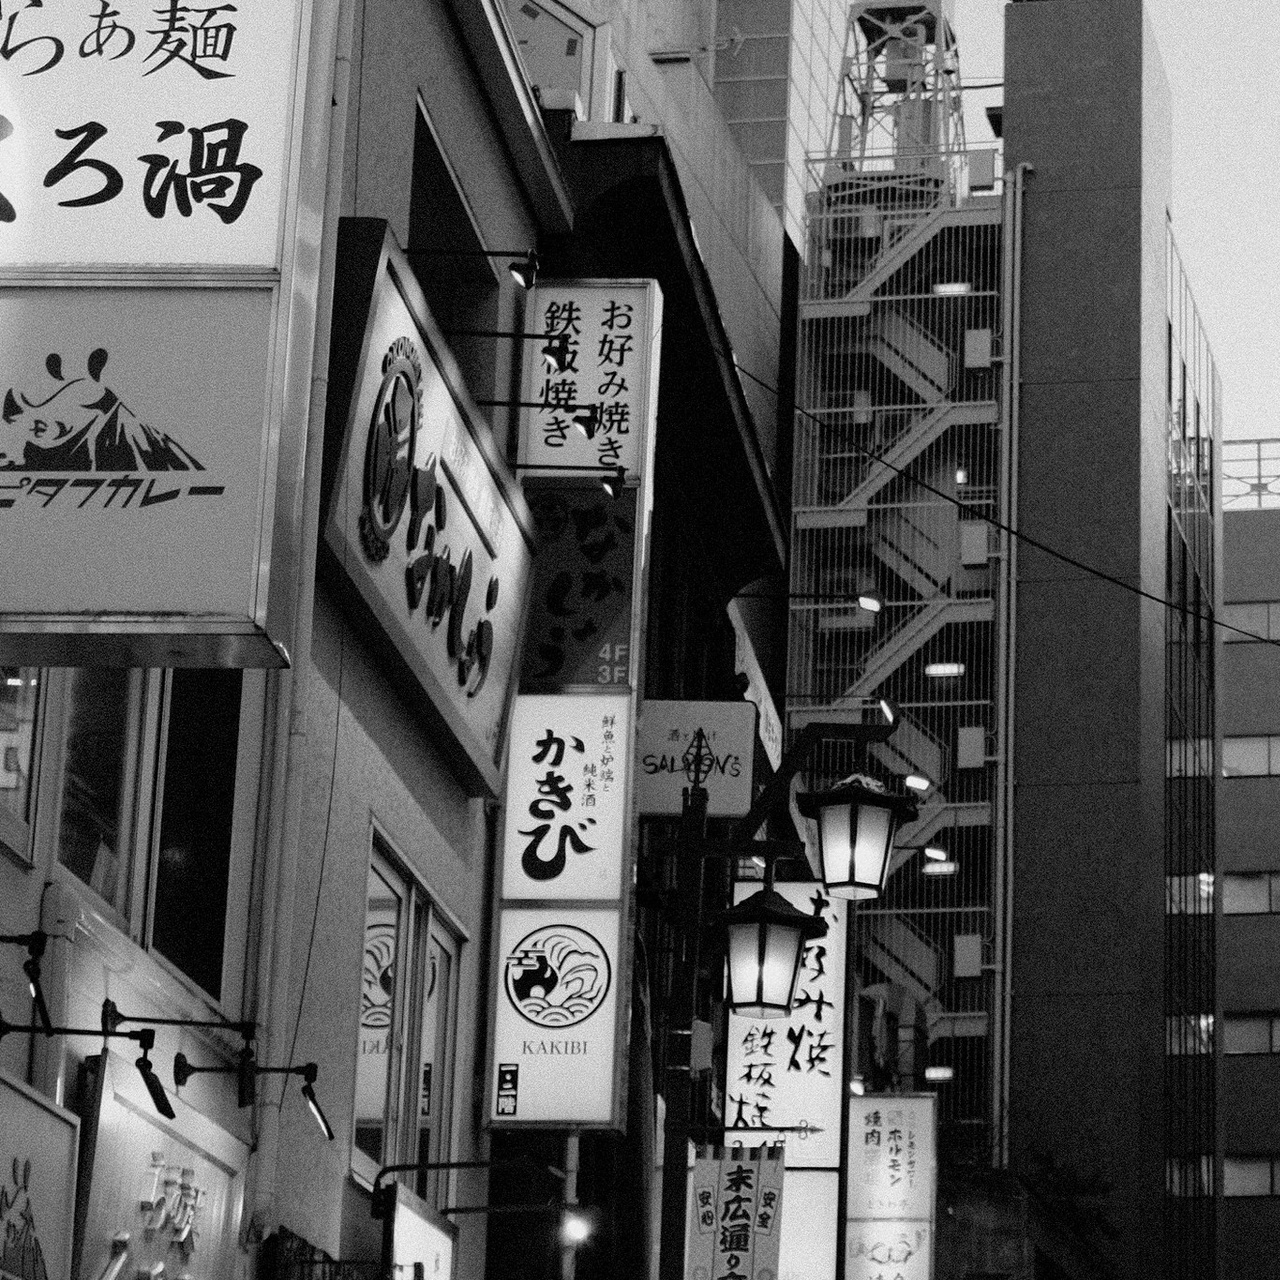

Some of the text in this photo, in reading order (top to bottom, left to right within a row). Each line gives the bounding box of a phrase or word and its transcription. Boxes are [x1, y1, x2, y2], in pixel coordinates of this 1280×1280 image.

[0, 117, 262, 226] ろ渦
[596, 300, 635, 468] お好み焼き
[598, 643, 628, 661] 4F
[597, 666, 628, 684] 3F
[516, 728, 598, 882] かきび
[580, 763, 598, 807] 純米酒
[521, 1040, 590, 1056] KAKIBI
[729, 1025, 779, 1127] 鉄板焼
[756, 1190, 777, 1229] 安全
